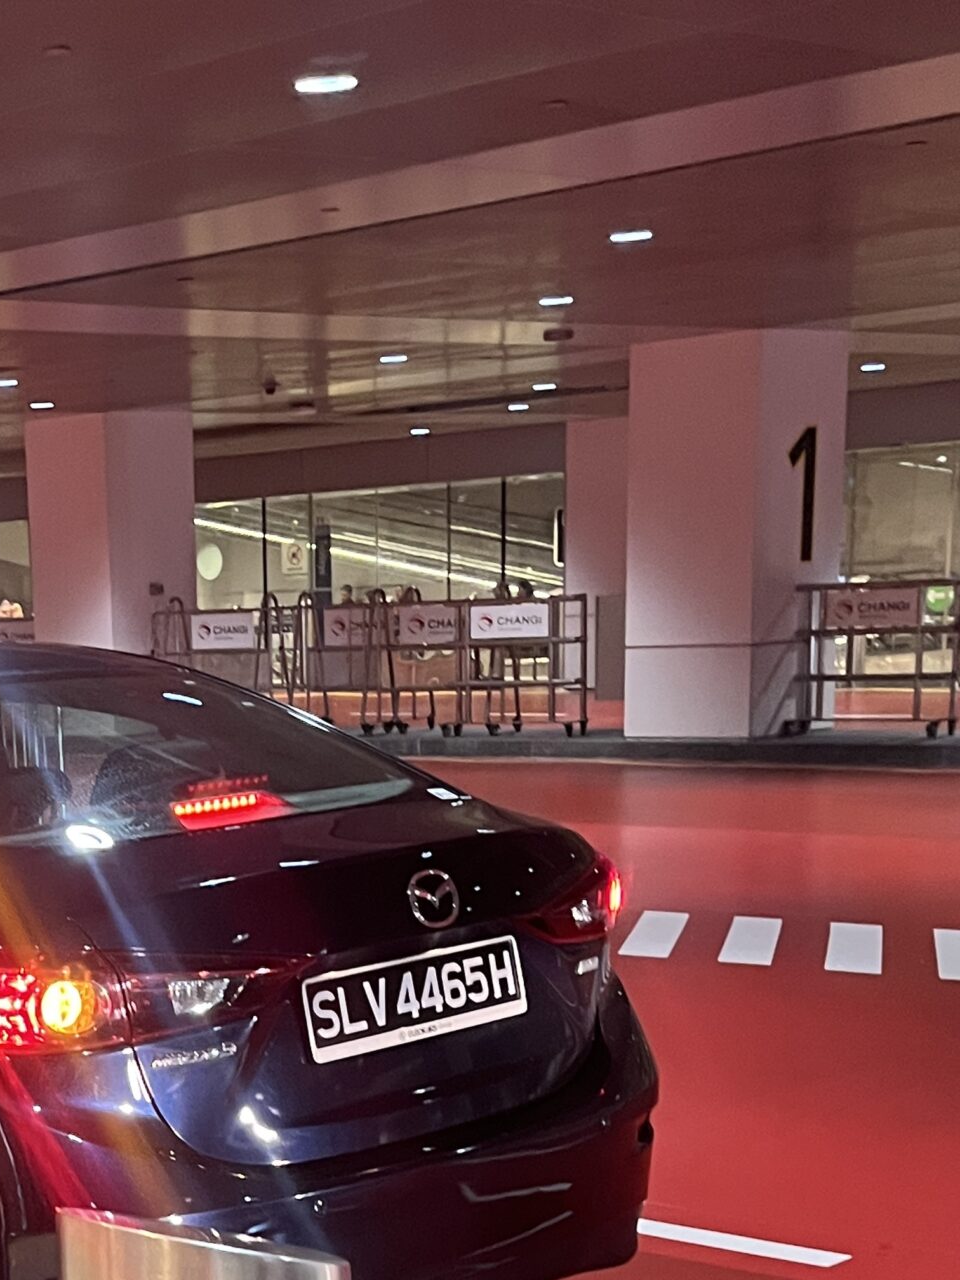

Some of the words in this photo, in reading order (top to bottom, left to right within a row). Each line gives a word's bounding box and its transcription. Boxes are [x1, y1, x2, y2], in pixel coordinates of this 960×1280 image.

[788, 426, 817, 561] 1
[858, 601, 910, 612] CHANGI
[427, 618, 454, 630] CHA
[496, 615, 542, 626] CHANGI
